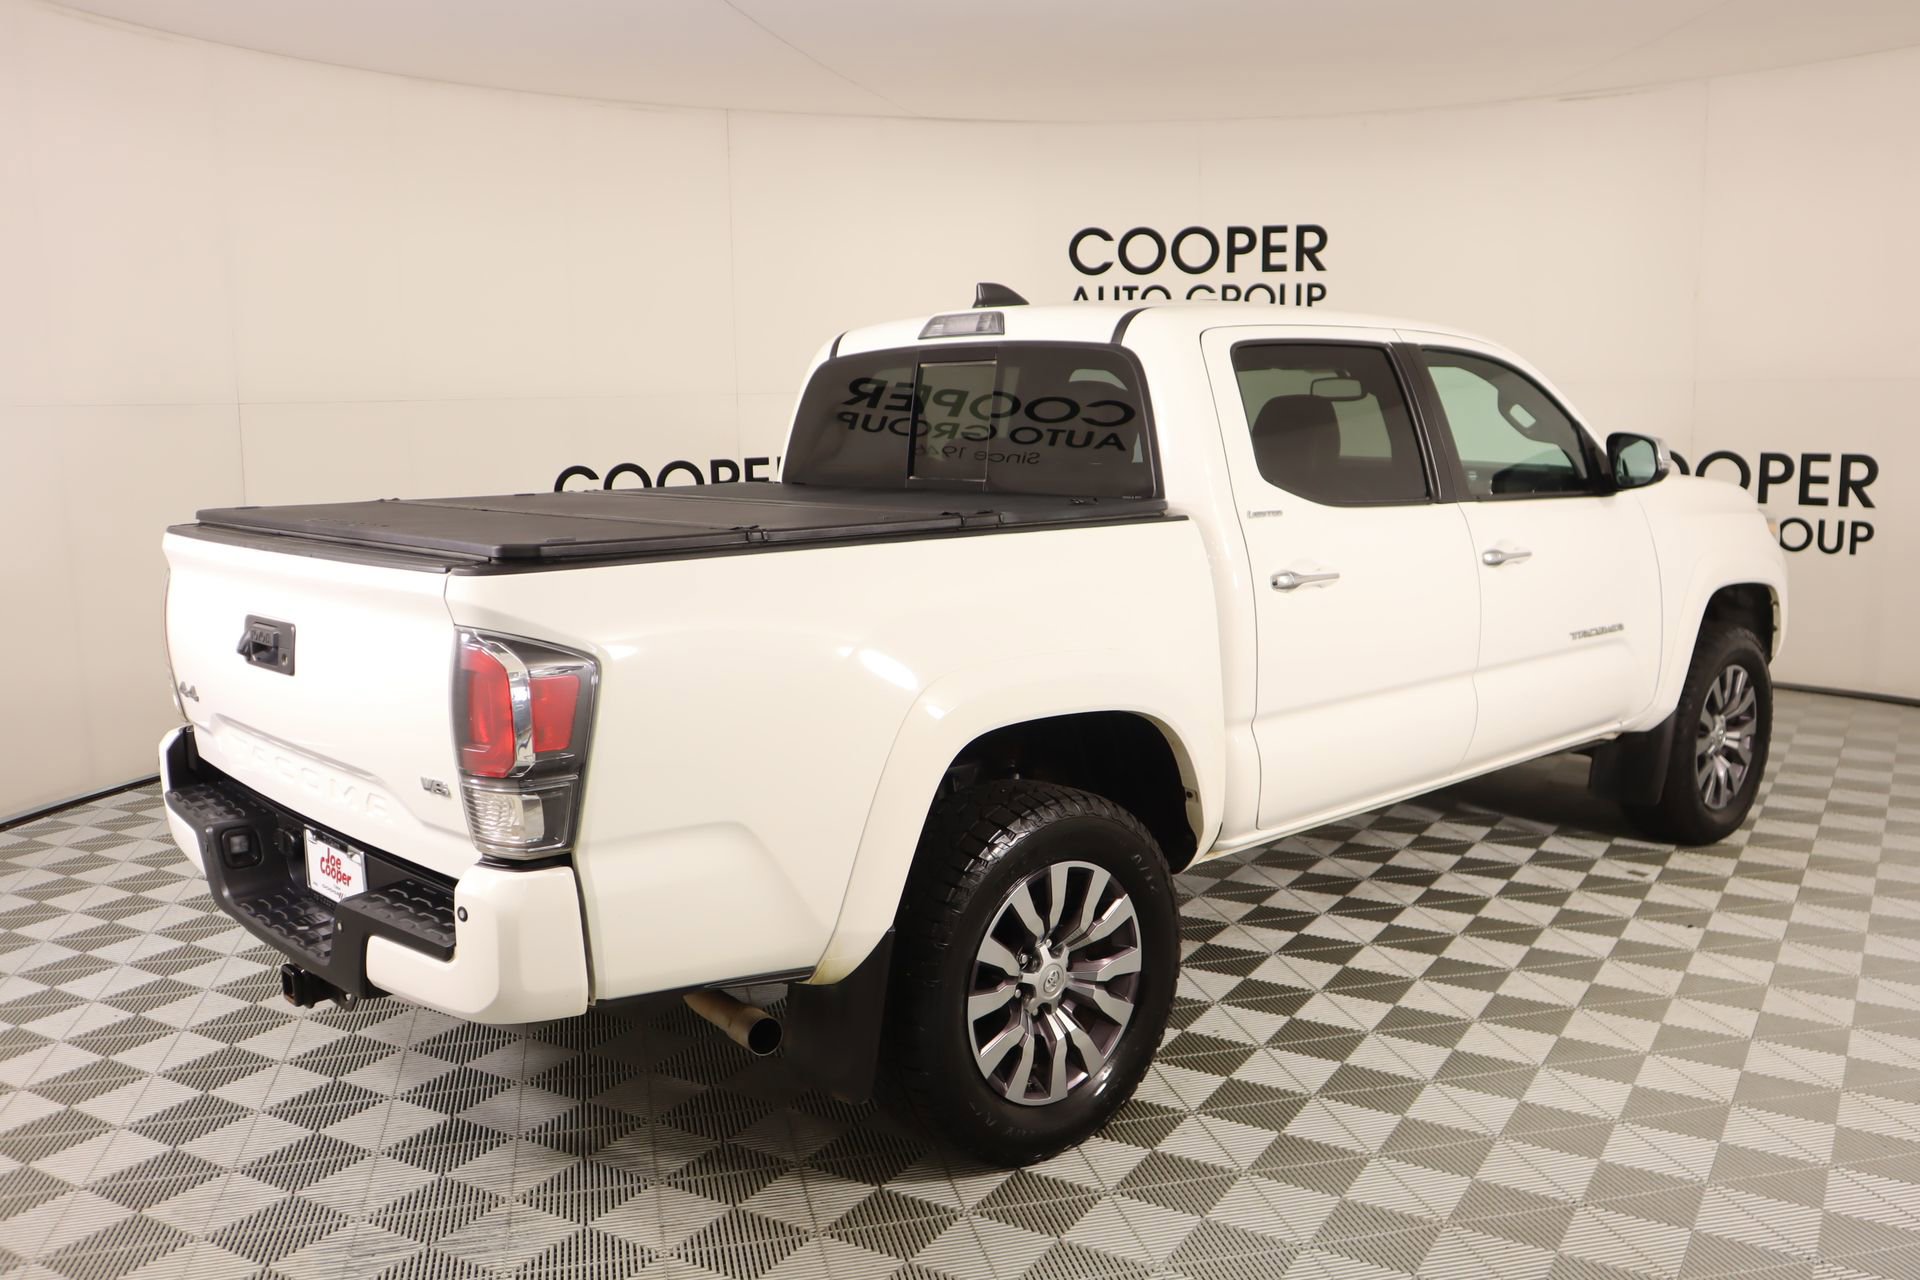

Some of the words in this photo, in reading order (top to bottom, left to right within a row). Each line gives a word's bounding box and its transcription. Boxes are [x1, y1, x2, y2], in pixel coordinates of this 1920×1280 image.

[1069, 224, 1328, 275] COOPER
[320, 856, 352, 887] Cooper
[326, 847, 342, 870] Joe
